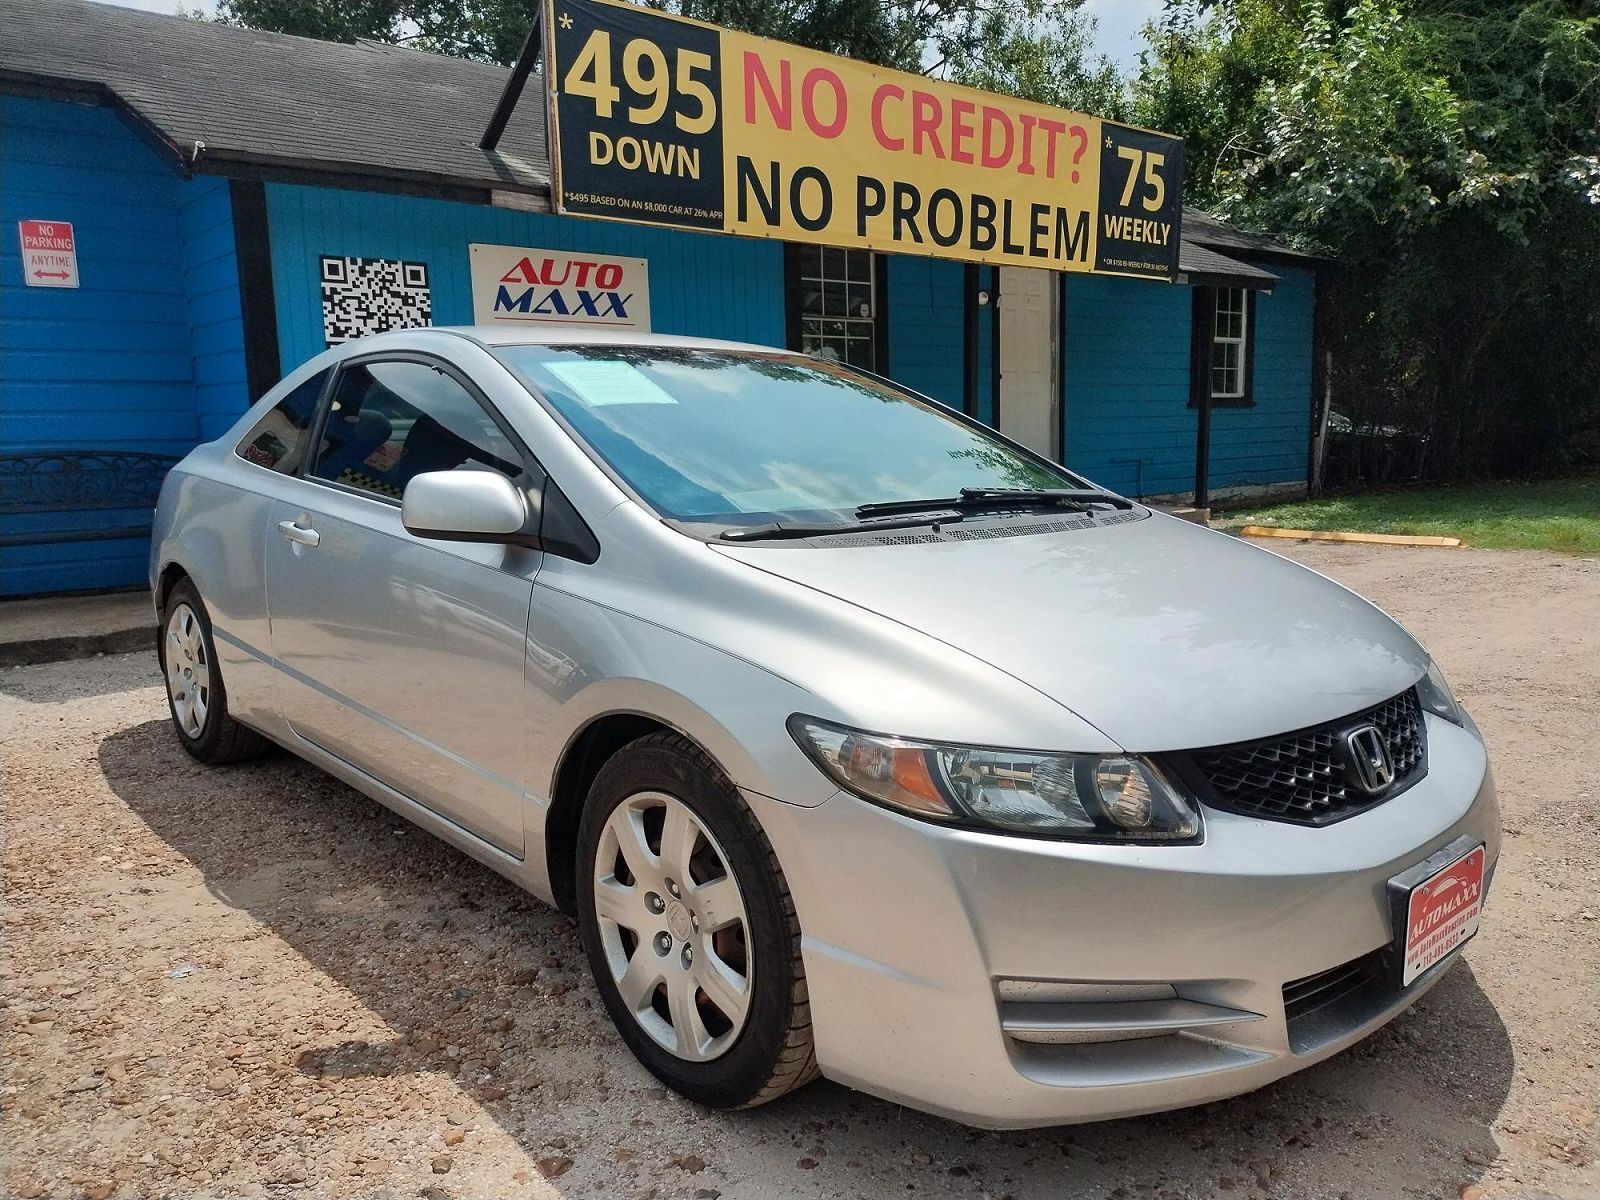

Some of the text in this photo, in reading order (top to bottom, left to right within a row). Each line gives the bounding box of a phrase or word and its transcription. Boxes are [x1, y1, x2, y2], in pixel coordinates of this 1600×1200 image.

[744, 50, 1088, 184] NO CREDIT?
[589, 131, 700, 179] DOWN
[590, 195, 616, 206] BASED
[618, 198, 630, 208] ON
[631, 201, 643, 210] AN
[644, 202, 668, 213] $8,000
[668, 205, 683, 214] CAR
[684, 207, 693, 216] AT
[694, 208, 708, 218] 26%
[709, 210, 723, 220] APR
[736, 155, 1090, 262] NO PROBLEM
[25, 236, 72, 249] PARKING
[38, 225, 54, 236] NO
[1104, 214, 1171, 246] WEEKLY
[31, 255, 71, 267] ANYTIME
[500, 257, 623, 289] AUTO
[493, 285, 634, 318] MAXX
[1409, 880, 1480, 943] AUTOMAXX
